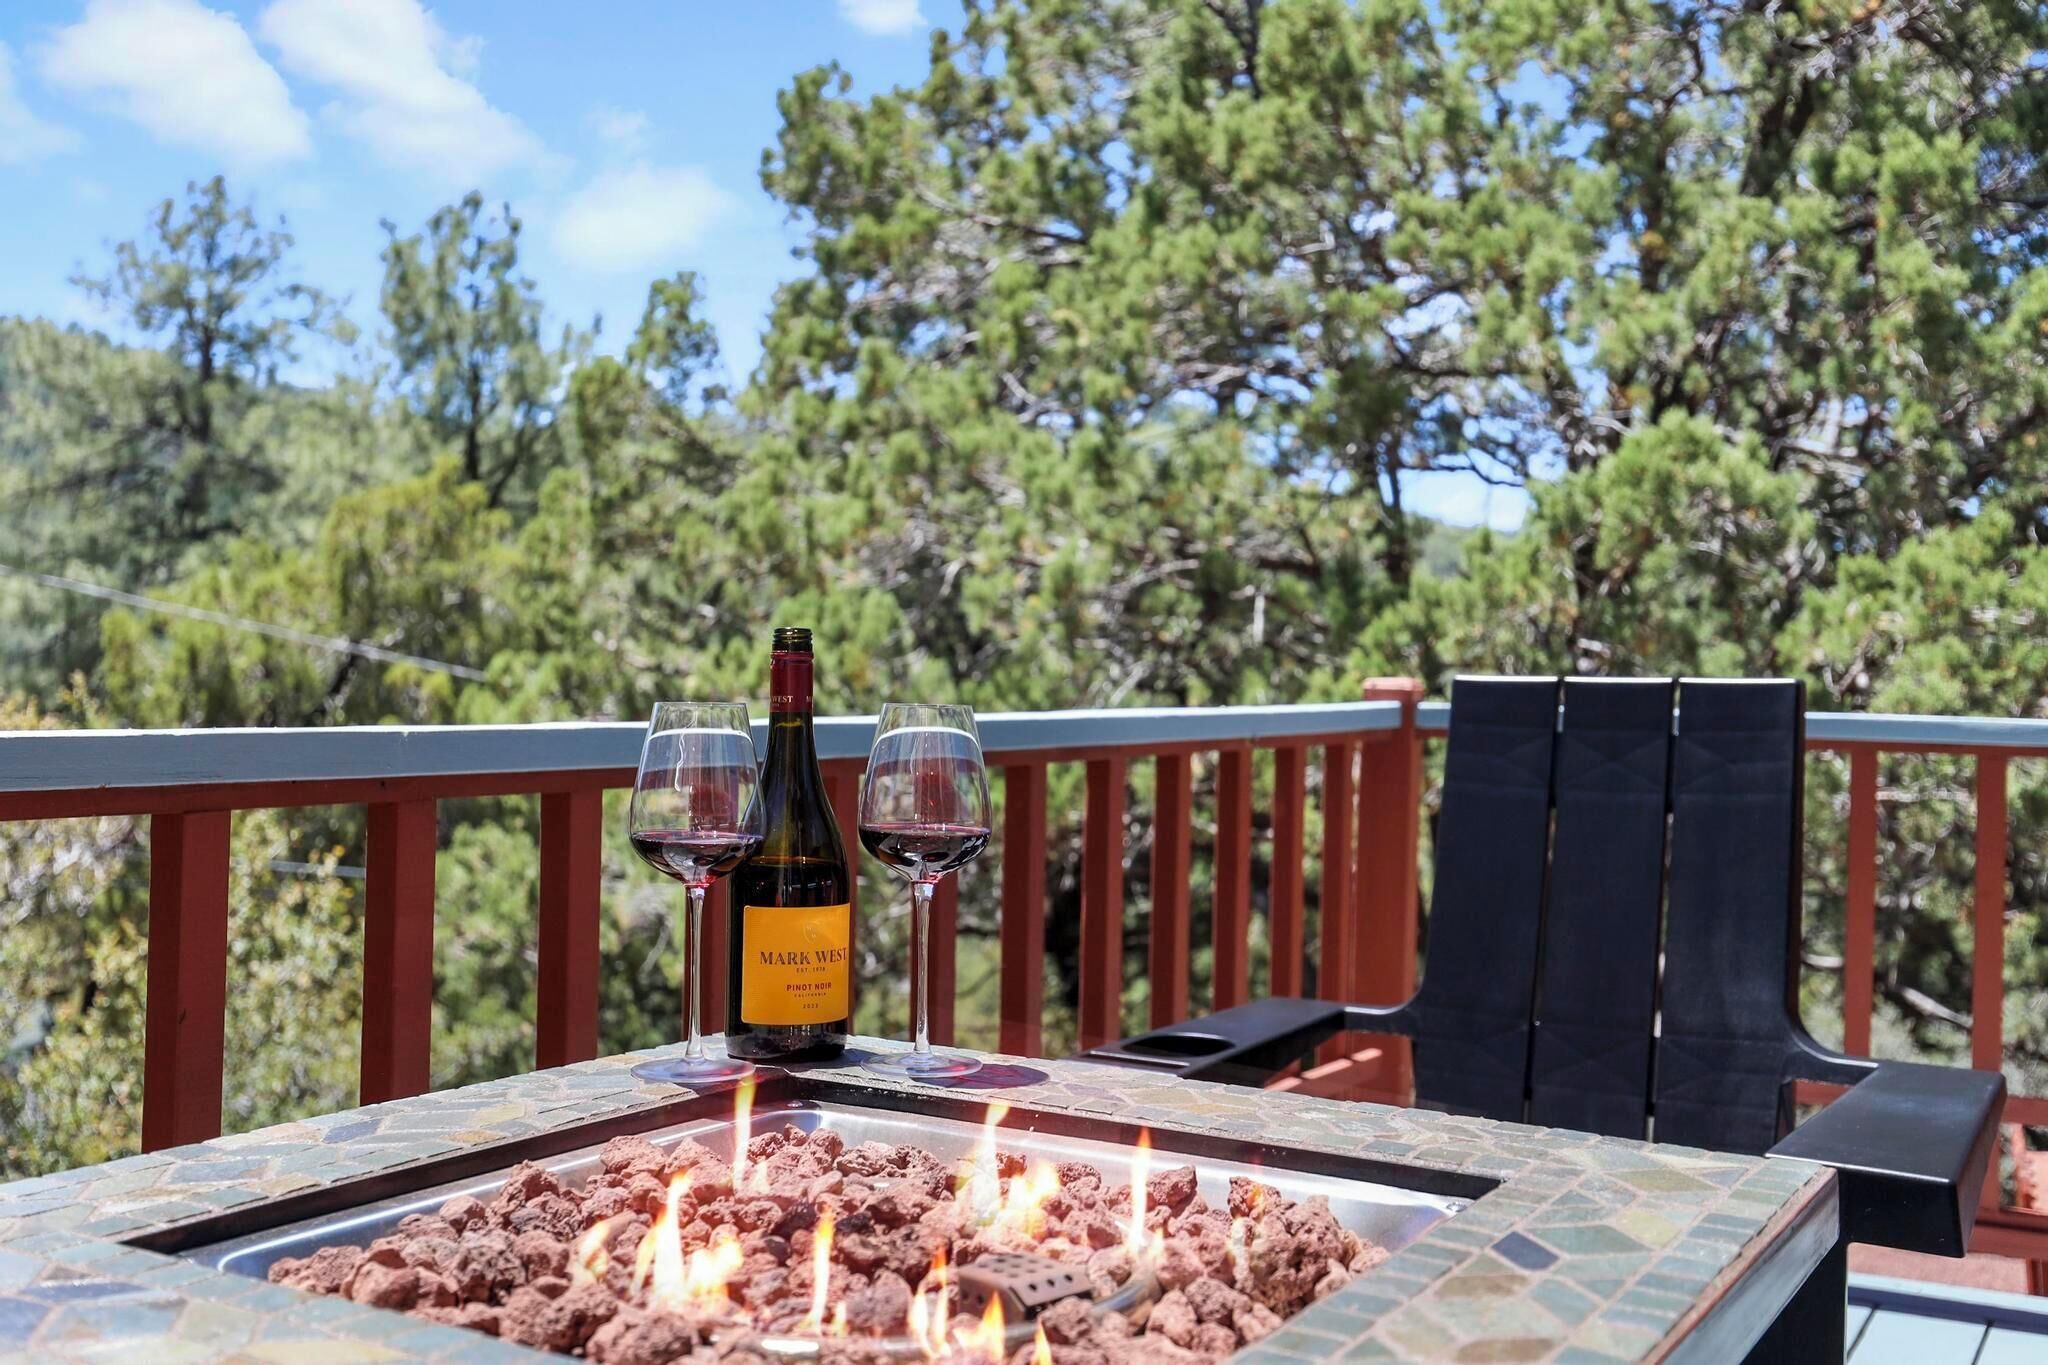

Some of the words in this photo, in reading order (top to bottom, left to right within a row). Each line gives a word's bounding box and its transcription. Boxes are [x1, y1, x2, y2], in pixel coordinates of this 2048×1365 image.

[760, 951, 811, 965] MARK
[815, 948, 847, 963] WEST
[815, 982, 832, 990] NOIR
